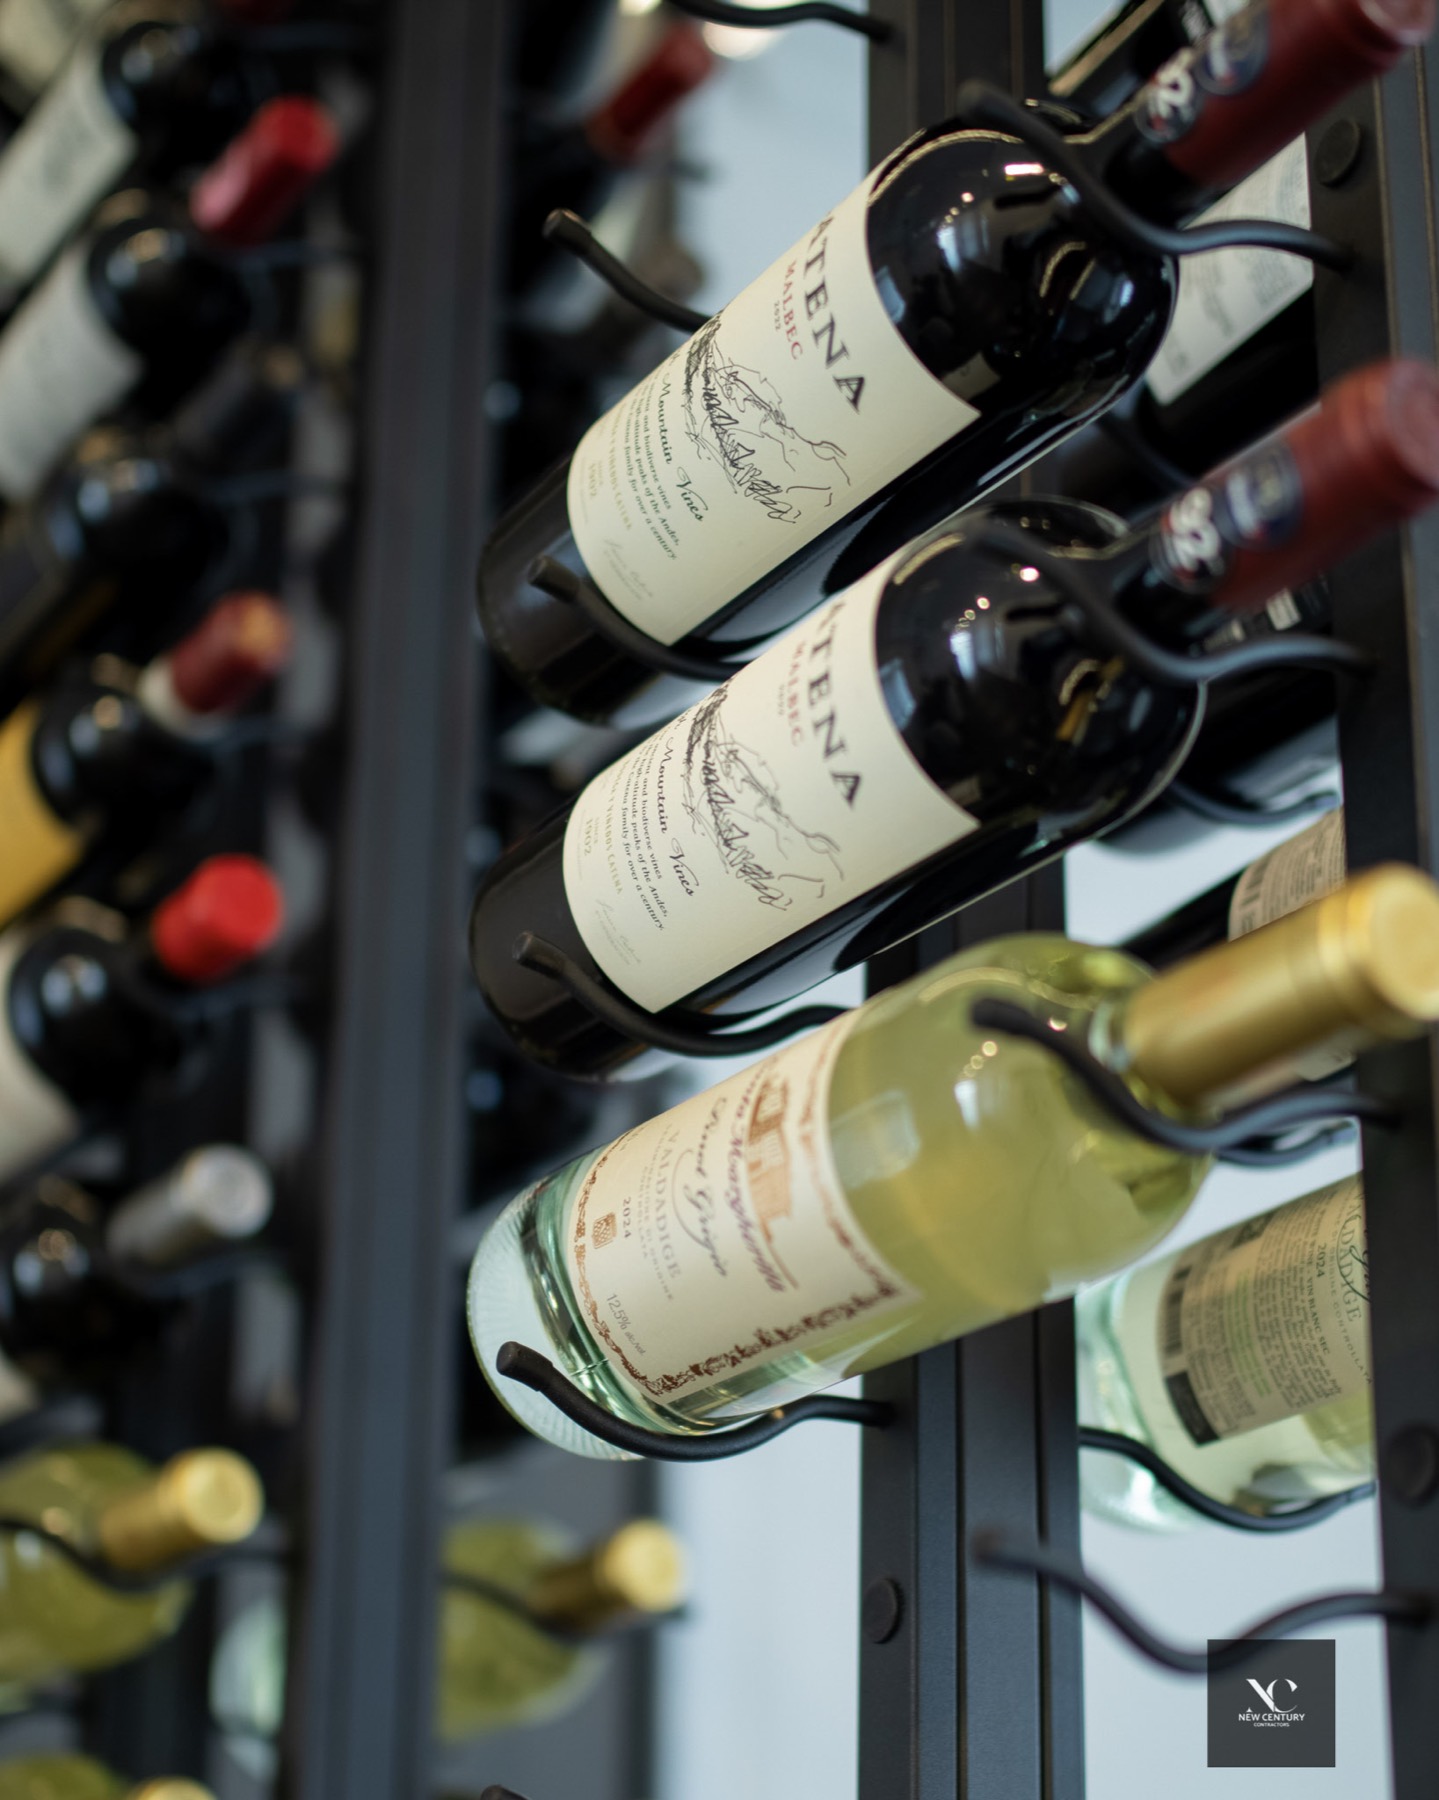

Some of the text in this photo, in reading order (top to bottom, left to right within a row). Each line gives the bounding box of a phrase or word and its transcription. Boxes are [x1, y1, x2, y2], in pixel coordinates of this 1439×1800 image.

[782, 260, 804, 361] MALBEC
[804, 214, 866, 413] ATENA
[643, 414, 651, 433] and
[624, 446, 635, 477] family
[644, 434, 659, 483] biodiverse
[657, 373, 709, 522] Mountain Vines
[628, 478, 638, 492] for
[656, 485, 672, 510] vines
[634, 458, 648, 485] peaks
[644, 486, 654, 497] of
[650, 499, 661, 514] the
[658, 516, 681, 546] Andes,
[634, 494, 648, 516] over
[645, 516, 653, 525] a
[809, 600, 862, 808] ATENA
[632, 758, 646, 819] high-altitude
[621, 808, 629, 839] family
[656, 737, 700, 897] Mountain Vines
[622, 842, 631, 857] for
[630, 822, 642, 851] peaks
[641, 800, 654, 850] biodiverse
[649, 853, 663, 880] vines
[626, 860, 639, 882] over
[637, 853, 647, 864] of
[641, 866, 652, 883] the
[635, 884, 643, 892] a
[648, 884, 669, 917] Andes,
[639, 893, 665, 930] century.
[622, 1196, 633, 1239] 2024
[656, 1130, 681, 1279] VALDADIGE
[1316, 1242, 1327, 1278] 2024
[1306, 1276, 1314, 1297] VIN
[605, 1292, 632, 1331] 12.5%
[1308, 1297, 1323, 1333] BLANC
[1318, 1335, 1331, 1355] SEC
